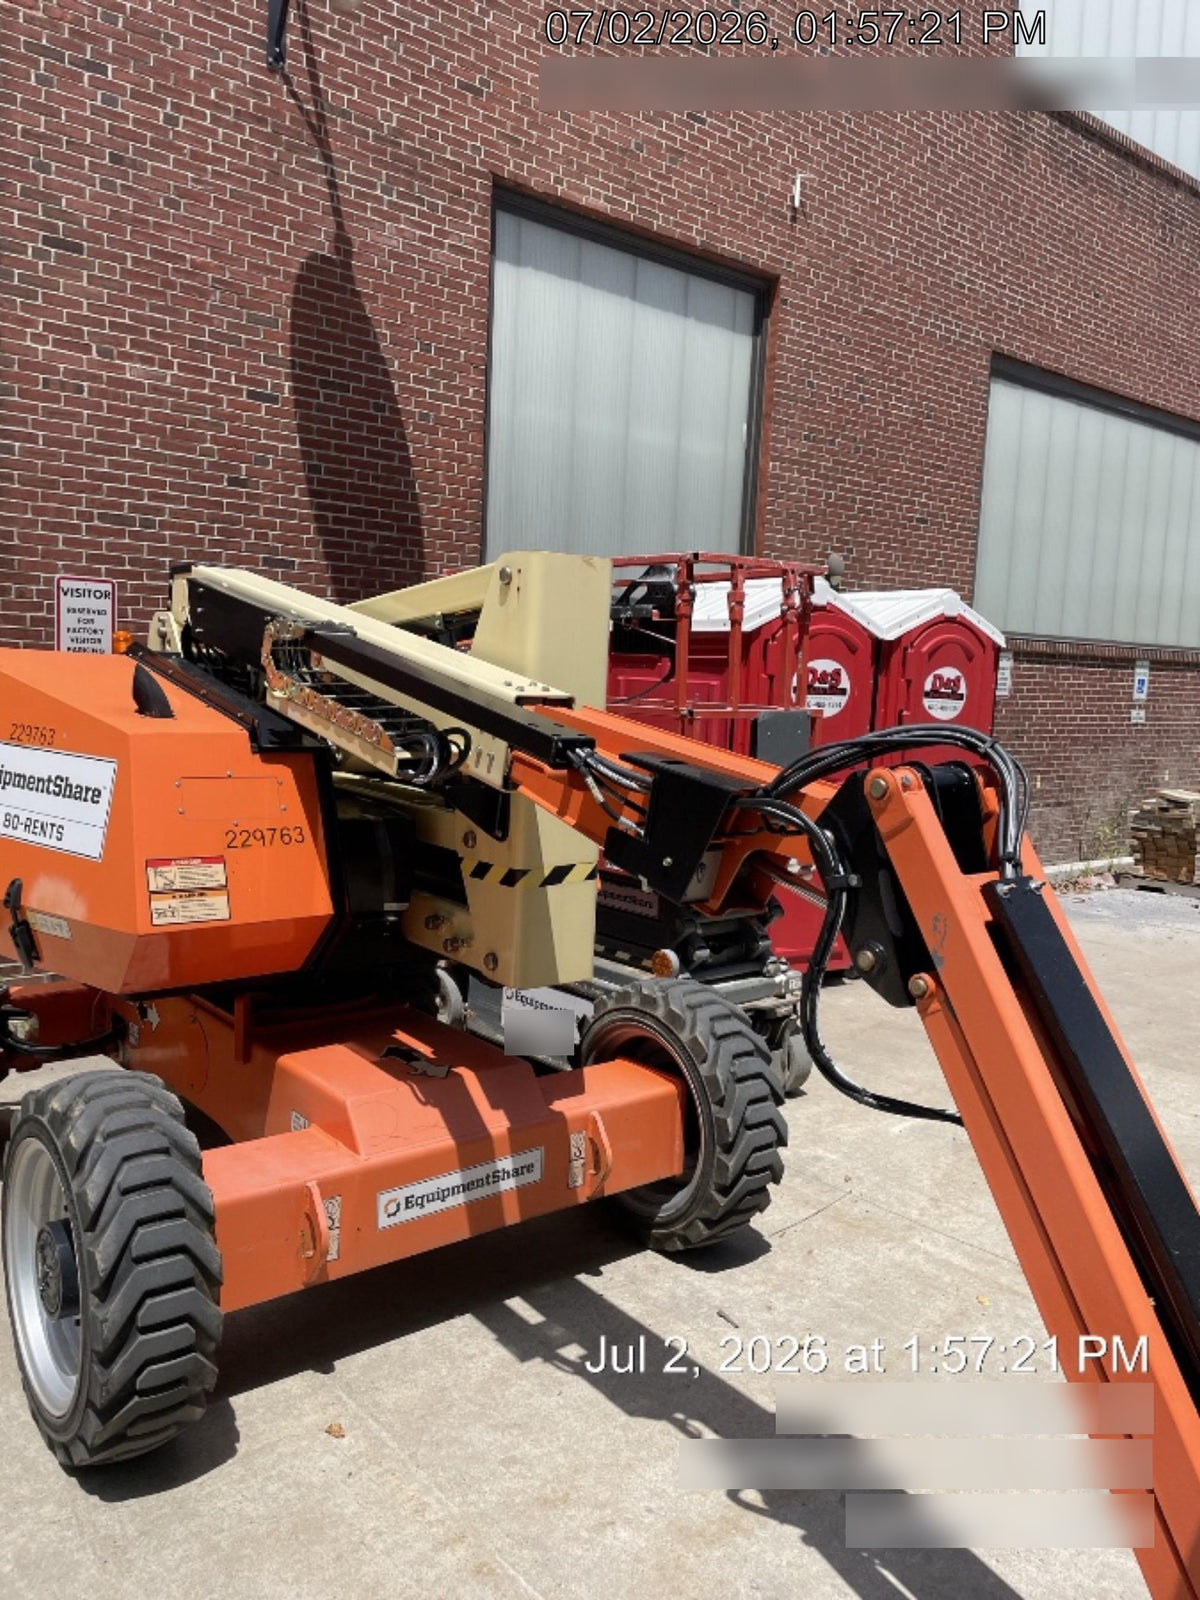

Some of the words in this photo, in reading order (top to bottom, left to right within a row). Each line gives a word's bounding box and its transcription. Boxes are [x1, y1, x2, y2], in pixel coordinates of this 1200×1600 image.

[61, 587, 111, 600] VISITOR
[9, 722, 56, 746] 229763
[225, 826, 305, 849] 229763
[403, 1162, 535, 1210] EquipmentShare
